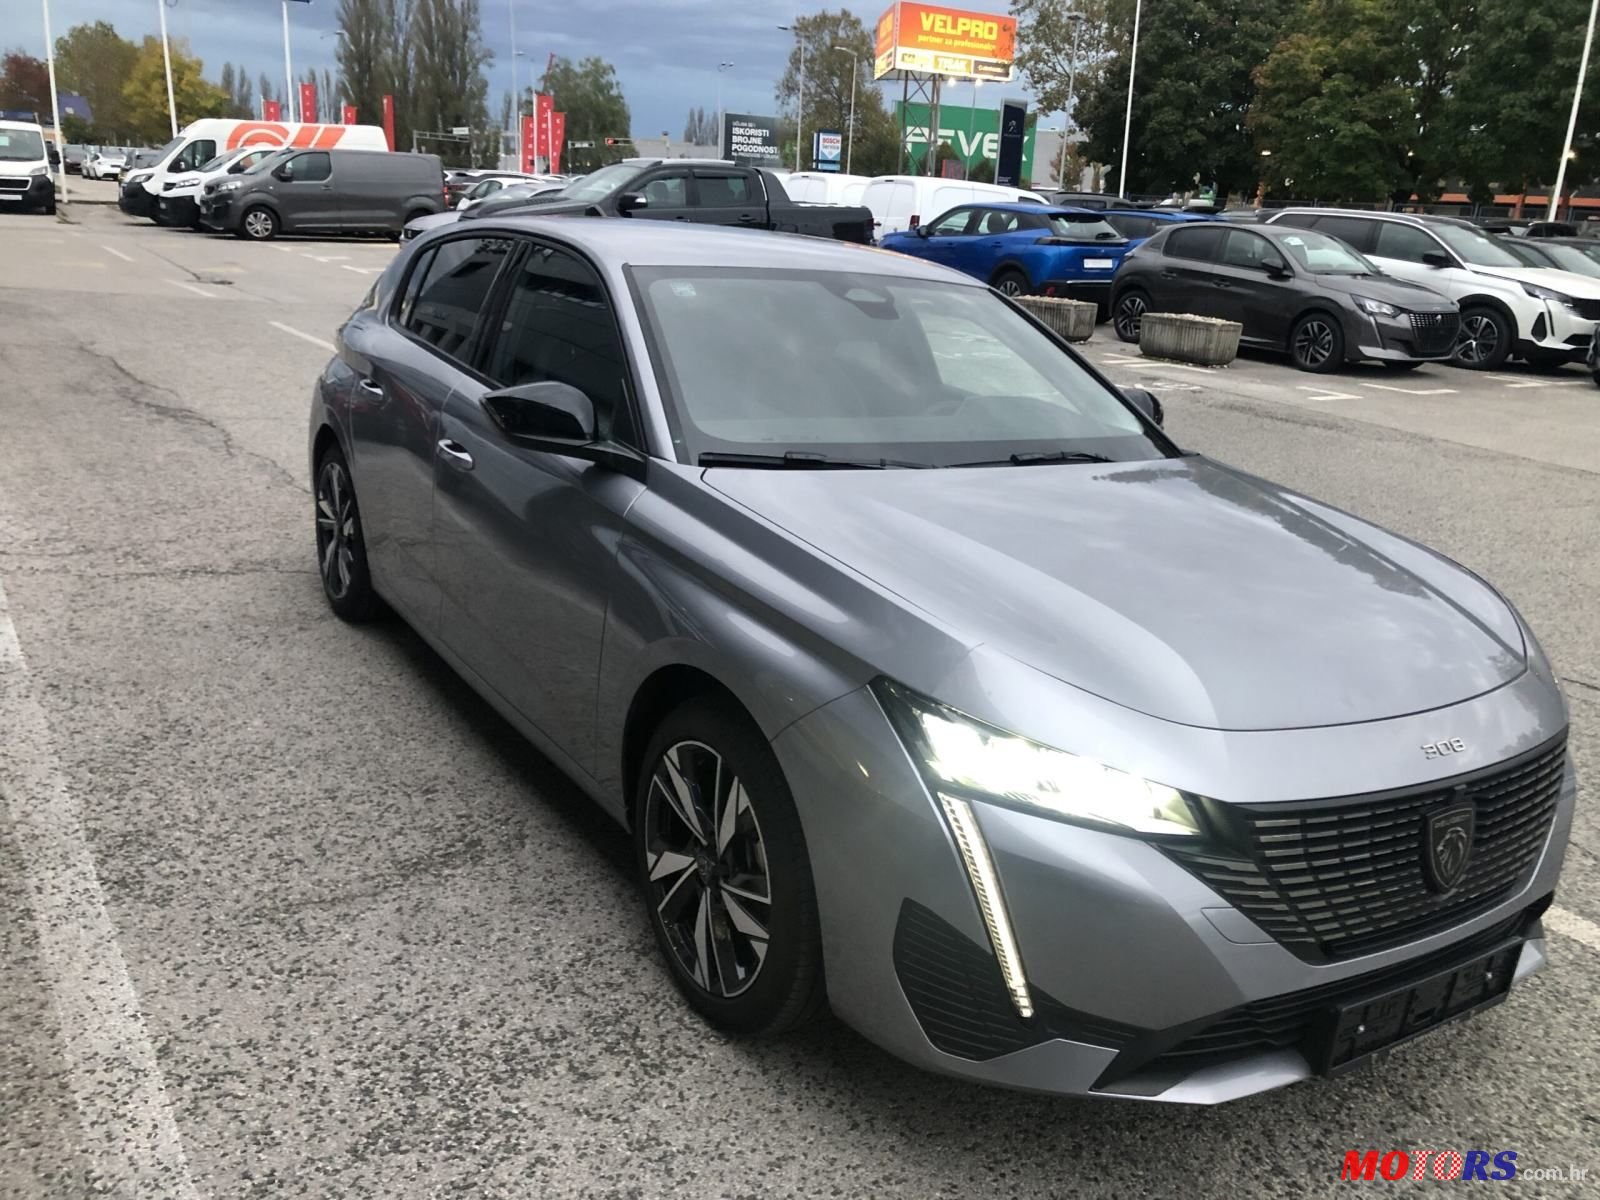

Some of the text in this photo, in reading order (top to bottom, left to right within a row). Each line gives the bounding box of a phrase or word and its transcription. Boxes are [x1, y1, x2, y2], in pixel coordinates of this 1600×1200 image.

[920, 11, 998, 41] VELPRO
[918, 35, 944, 45] partner
[732, 127, 769, 137] ISKORISTI
[732, 135, 763, 145] BROJNE
[732, 144, 780, 154] POGODNOST
[1420, 737, 1466, 760] 308
